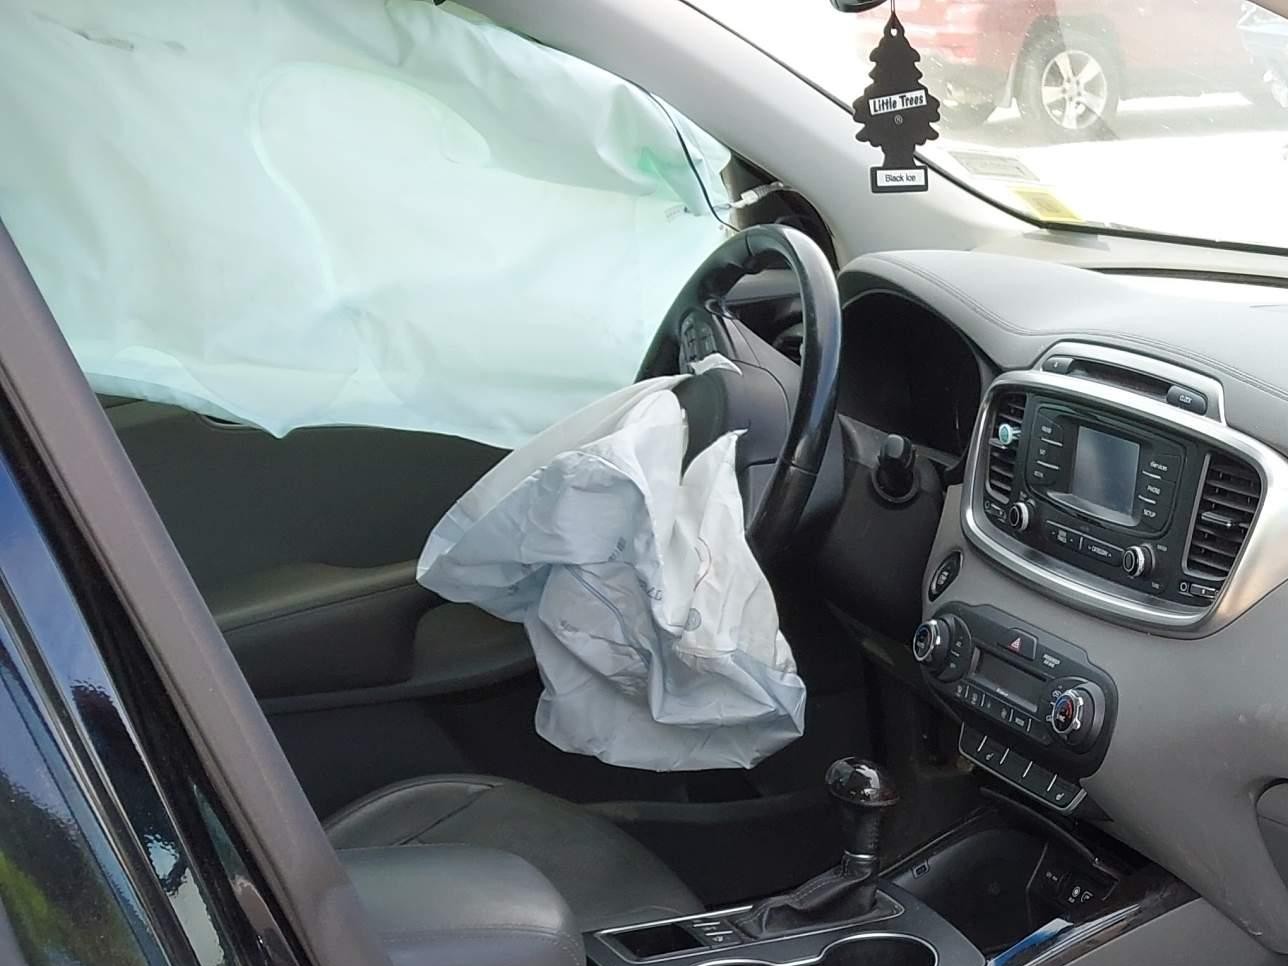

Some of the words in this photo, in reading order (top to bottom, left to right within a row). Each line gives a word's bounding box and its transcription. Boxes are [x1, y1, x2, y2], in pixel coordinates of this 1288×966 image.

[873, 96, 896, 112] Little
[899, 94, 924, 107] Trees
[885, 173, 903, 183] Black
[904, 173, 916, 183] Ice
